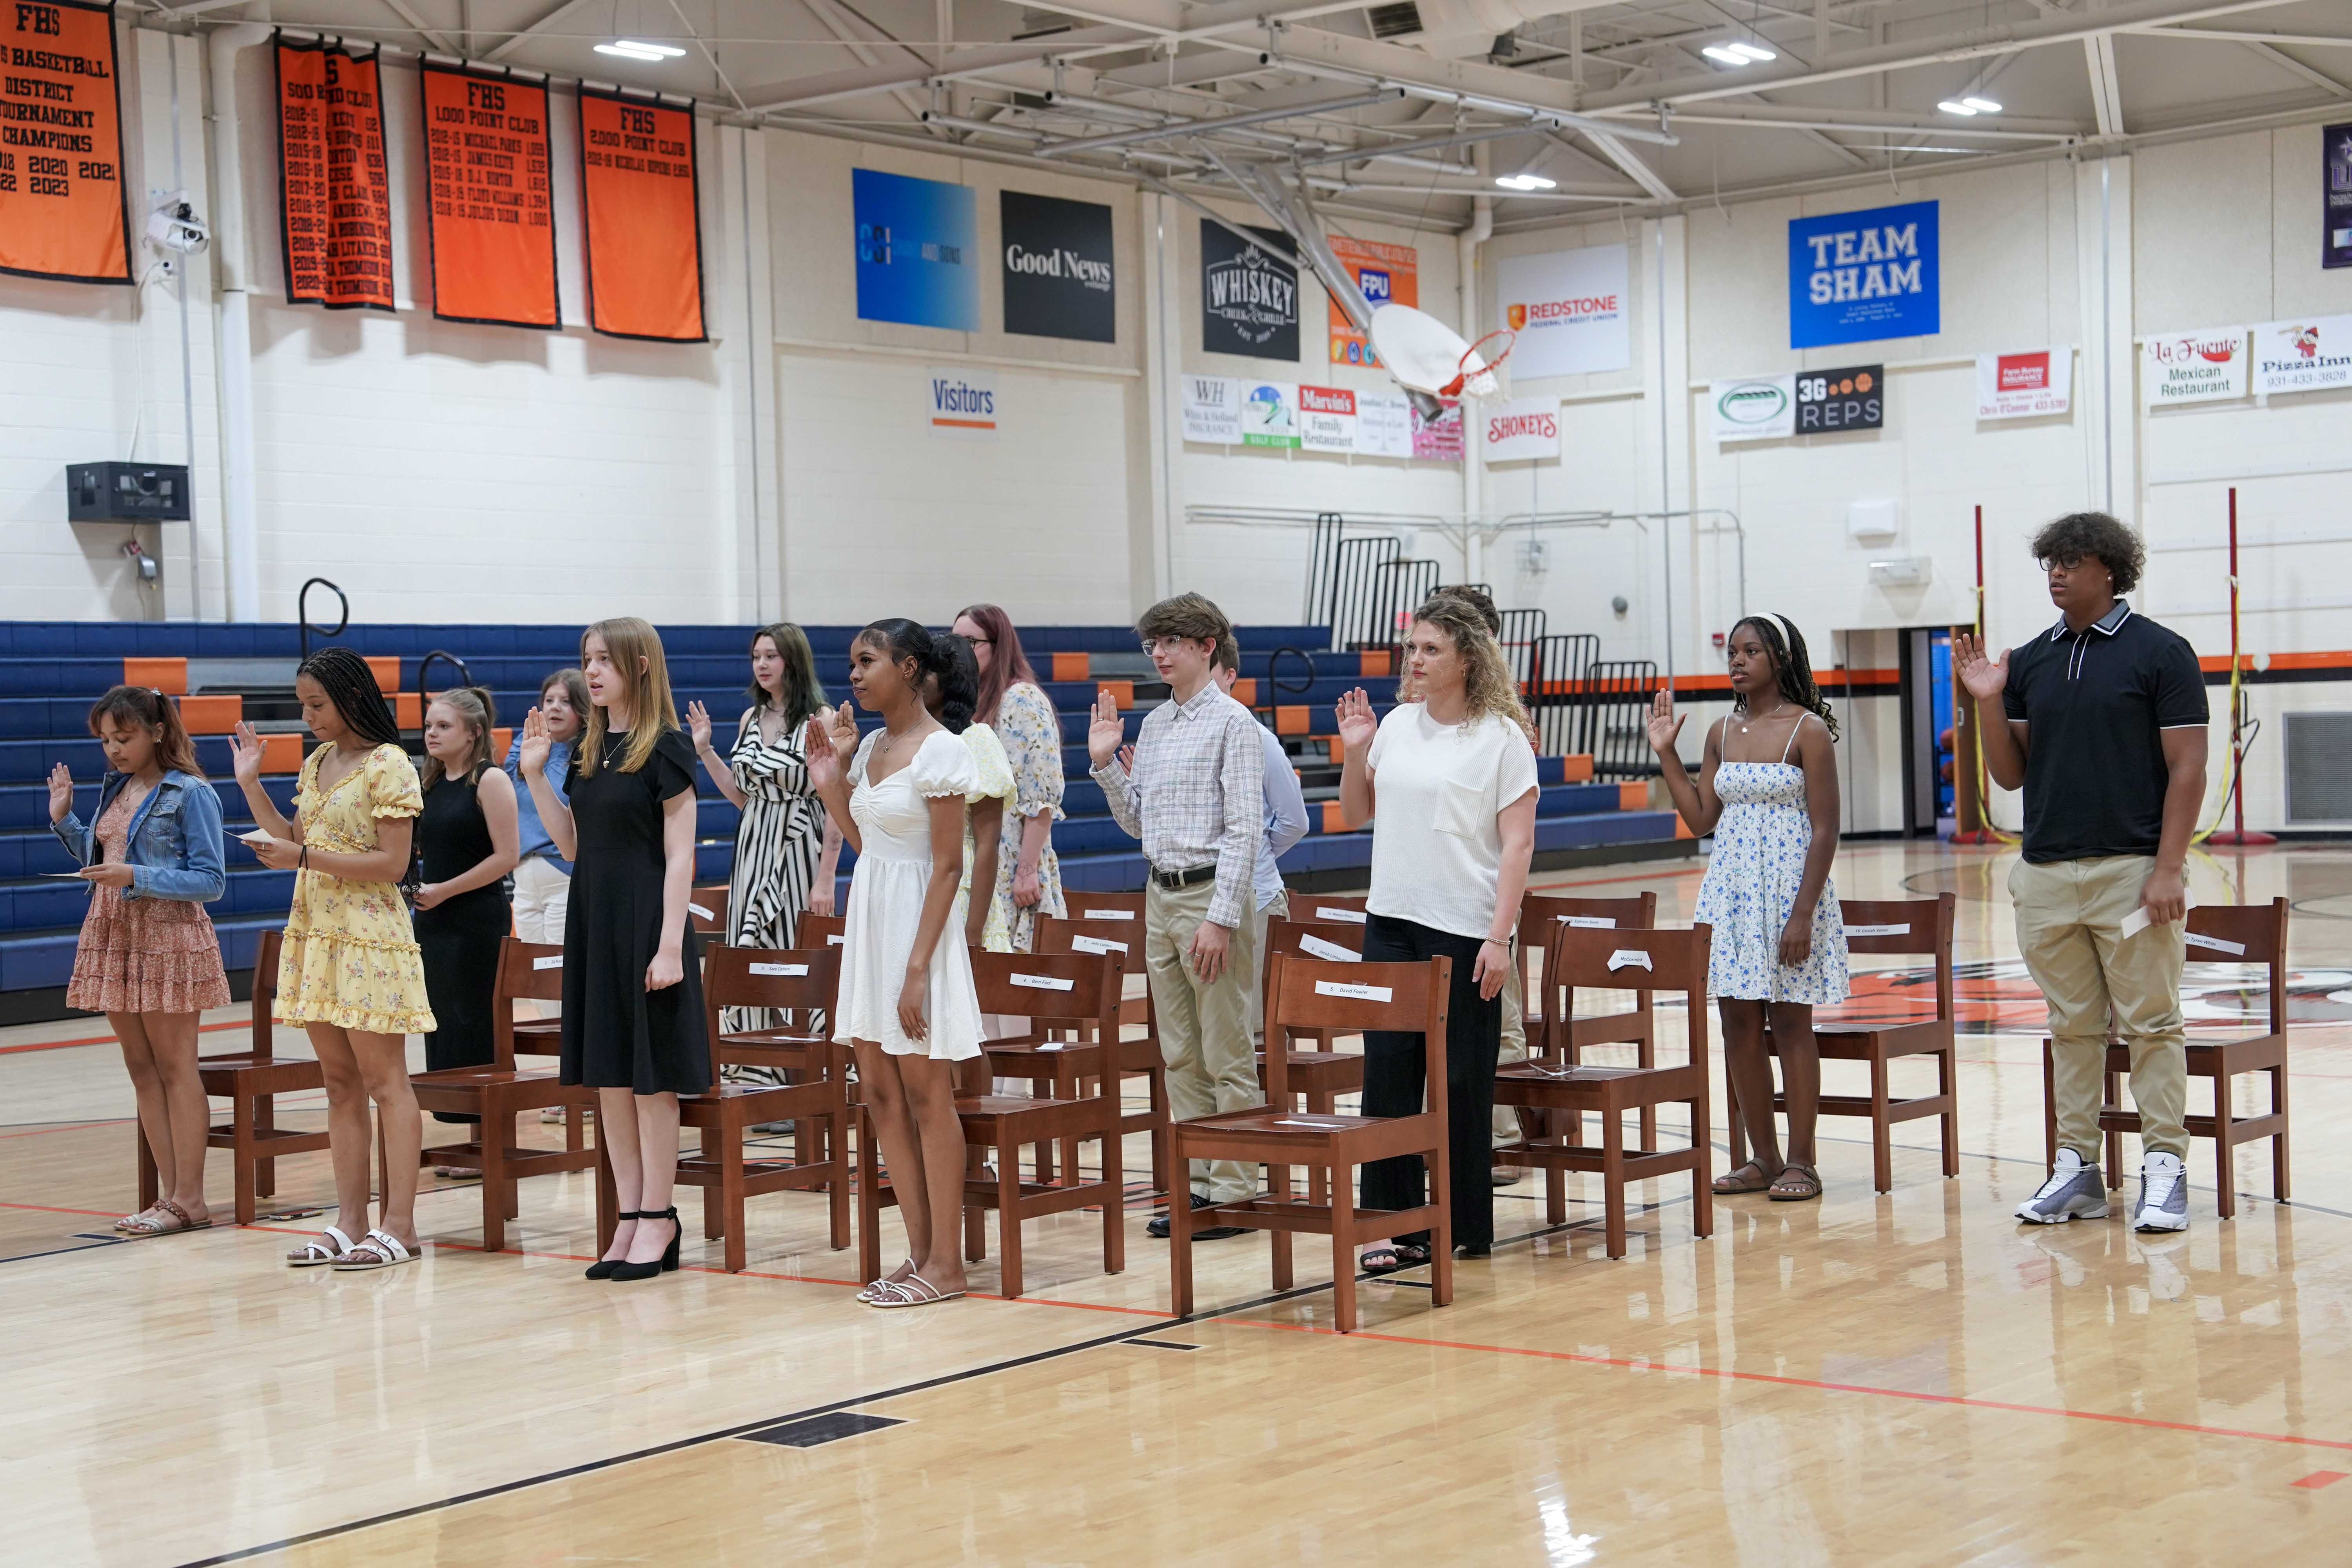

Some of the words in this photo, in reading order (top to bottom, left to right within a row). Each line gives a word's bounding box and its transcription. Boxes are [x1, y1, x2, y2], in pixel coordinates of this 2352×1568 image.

[16, 4, 60, 36] FHS
[5, 76, 74, 102] DISTRICT
[467, 82, 505, 110] FHS
[469, 110, 503, 129] POINT
[508, 116, 539, 134] CLUB
[621, 107, 655, 134] FHS
[3, 125, 92, 152] CHAMPIONS
[624, 134, 655, 152] POINT
[659, 139, 685, 157] CLUB
[29, 155, 68, 176] 2020
[79, 161, 115, 181] 2021
[30, 176, 69, 197] 2023
[1808, 222, 1918, 269] TEAM
[1006, 244, 1061, 277] Good
[1064, 250, 1111, 283] News
[1211, 269, 1293, 317] WHISKEY
[1360, 273, 1389, 298] FPU
[1809, 259, 1922, 305] SHAM
[1530, 295, 1617, 319] REDSTONE
[2149, 341, 2174, 366] La
[2176, 337, 2238, 362] Fuente
[2262, 359, 2316, 373] Pizza
[2318, 355, 2351, 367] Inn
[2169, 365, 2221, 382] Mexican
[2267, 370, 2347, 387] 931-433-3828
[932, 378, 994, 415] Visitors
[1196, 380, 1224, 402] WH
[1302, 389, 1352, 412] Marvin's
[2161, 379, 2230, 397] Restaurant
[1312, 416, 1343, 435] Family
[1802, 399, 1880, 428] REPS
[1303, 431, 1353, 447] Restaurant
[1488, 413, 1557, 443] SHONEY'S
